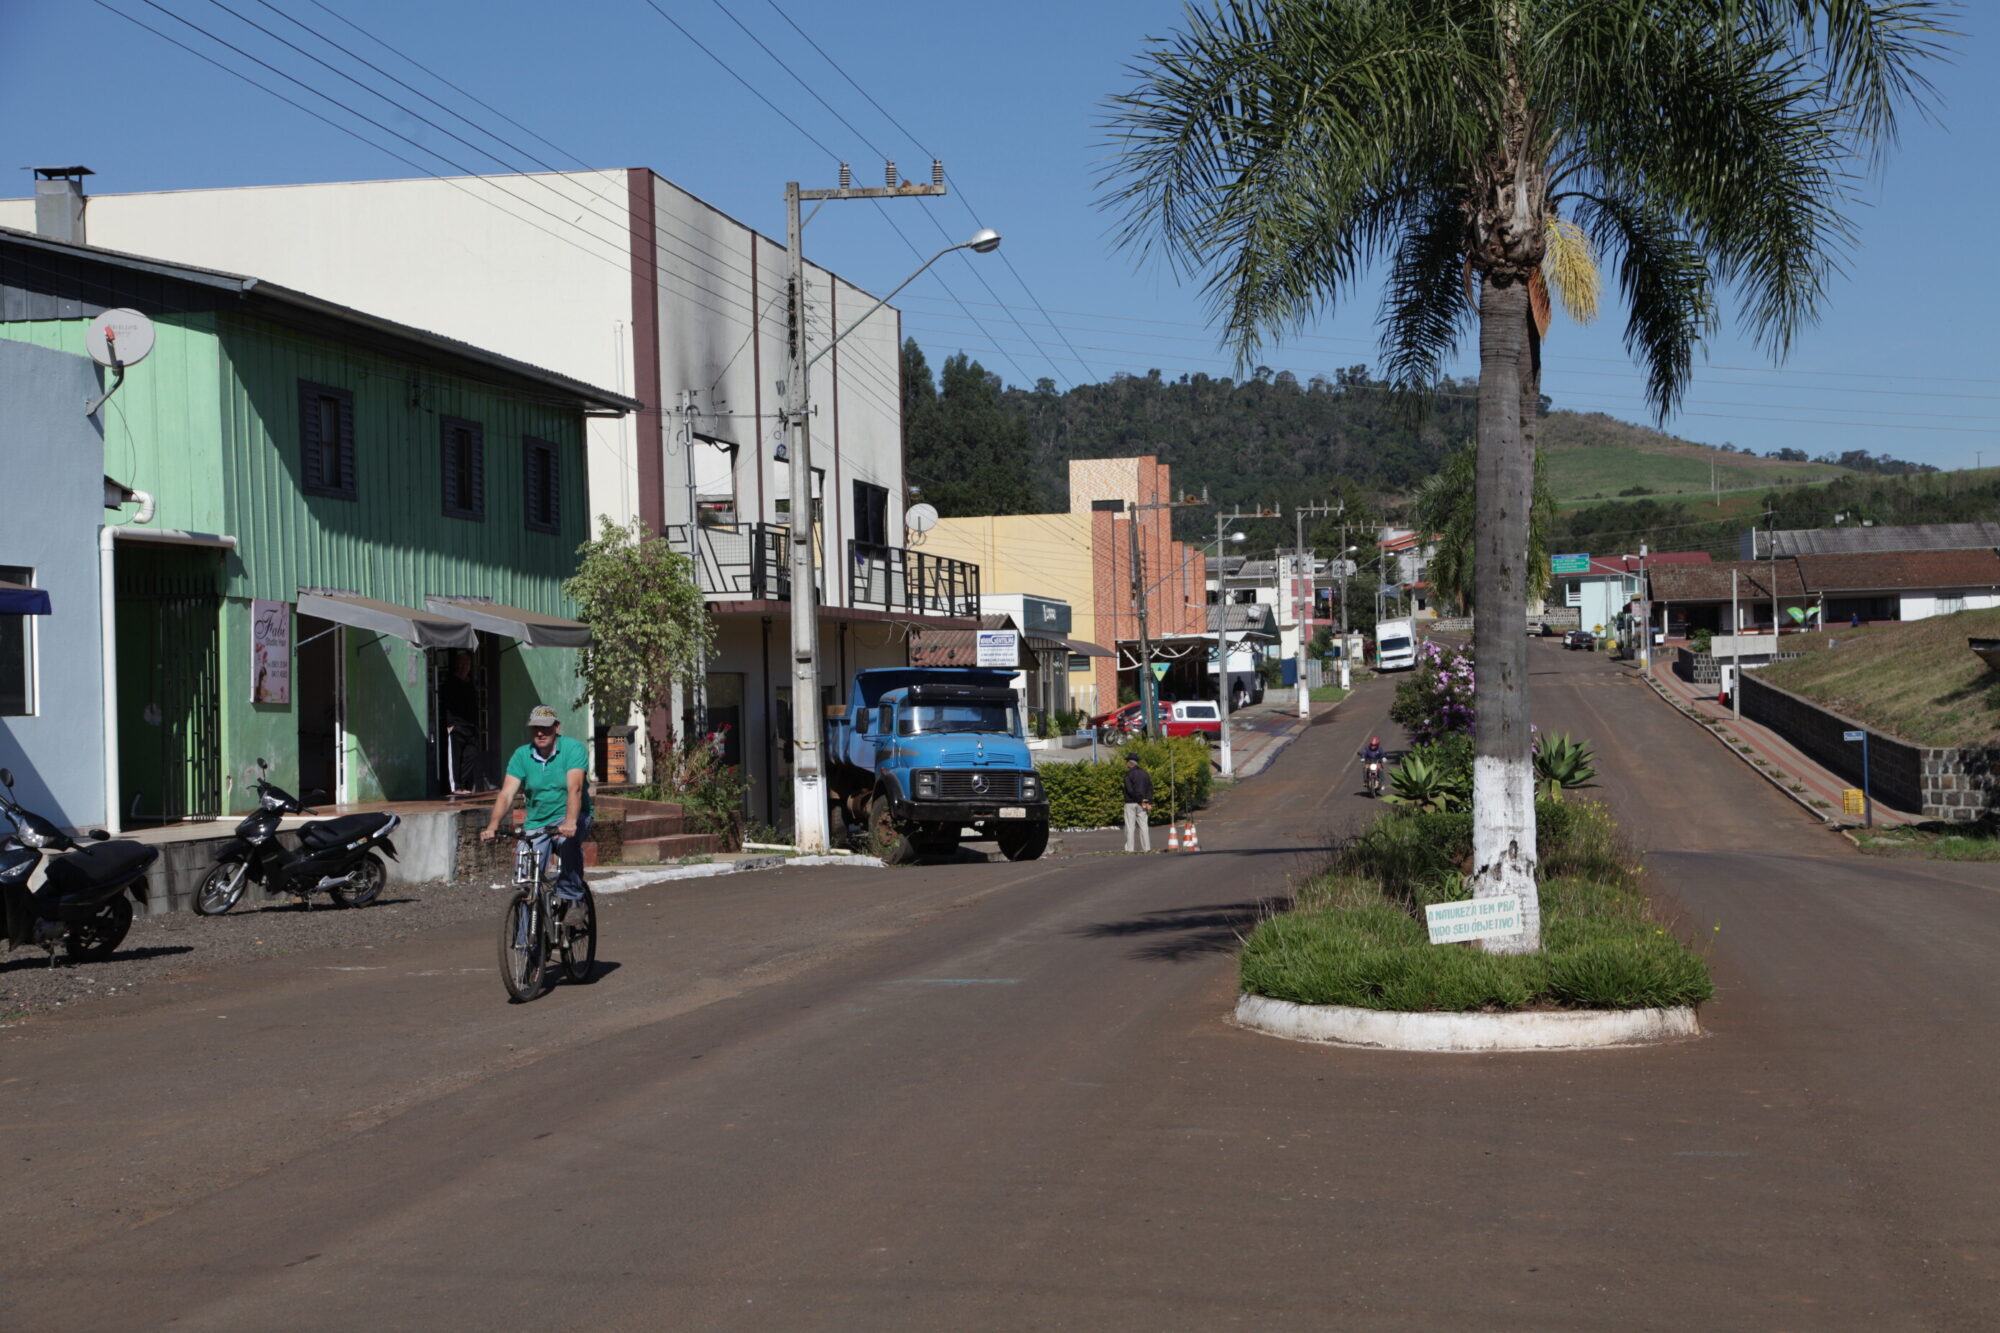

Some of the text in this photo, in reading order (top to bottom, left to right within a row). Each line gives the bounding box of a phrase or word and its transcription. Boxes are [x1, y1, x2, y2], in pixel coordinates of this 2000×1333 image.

[254, 609, 285, 640] Fabi
[1428, 900, 1516, 921] A NATUREZA TEM PRA
[1430, 924, 1451, 938] TUDO
[1453, 923, 1469, 935] SEU
[1472, 917, 1513, 931] OBJETIVO
